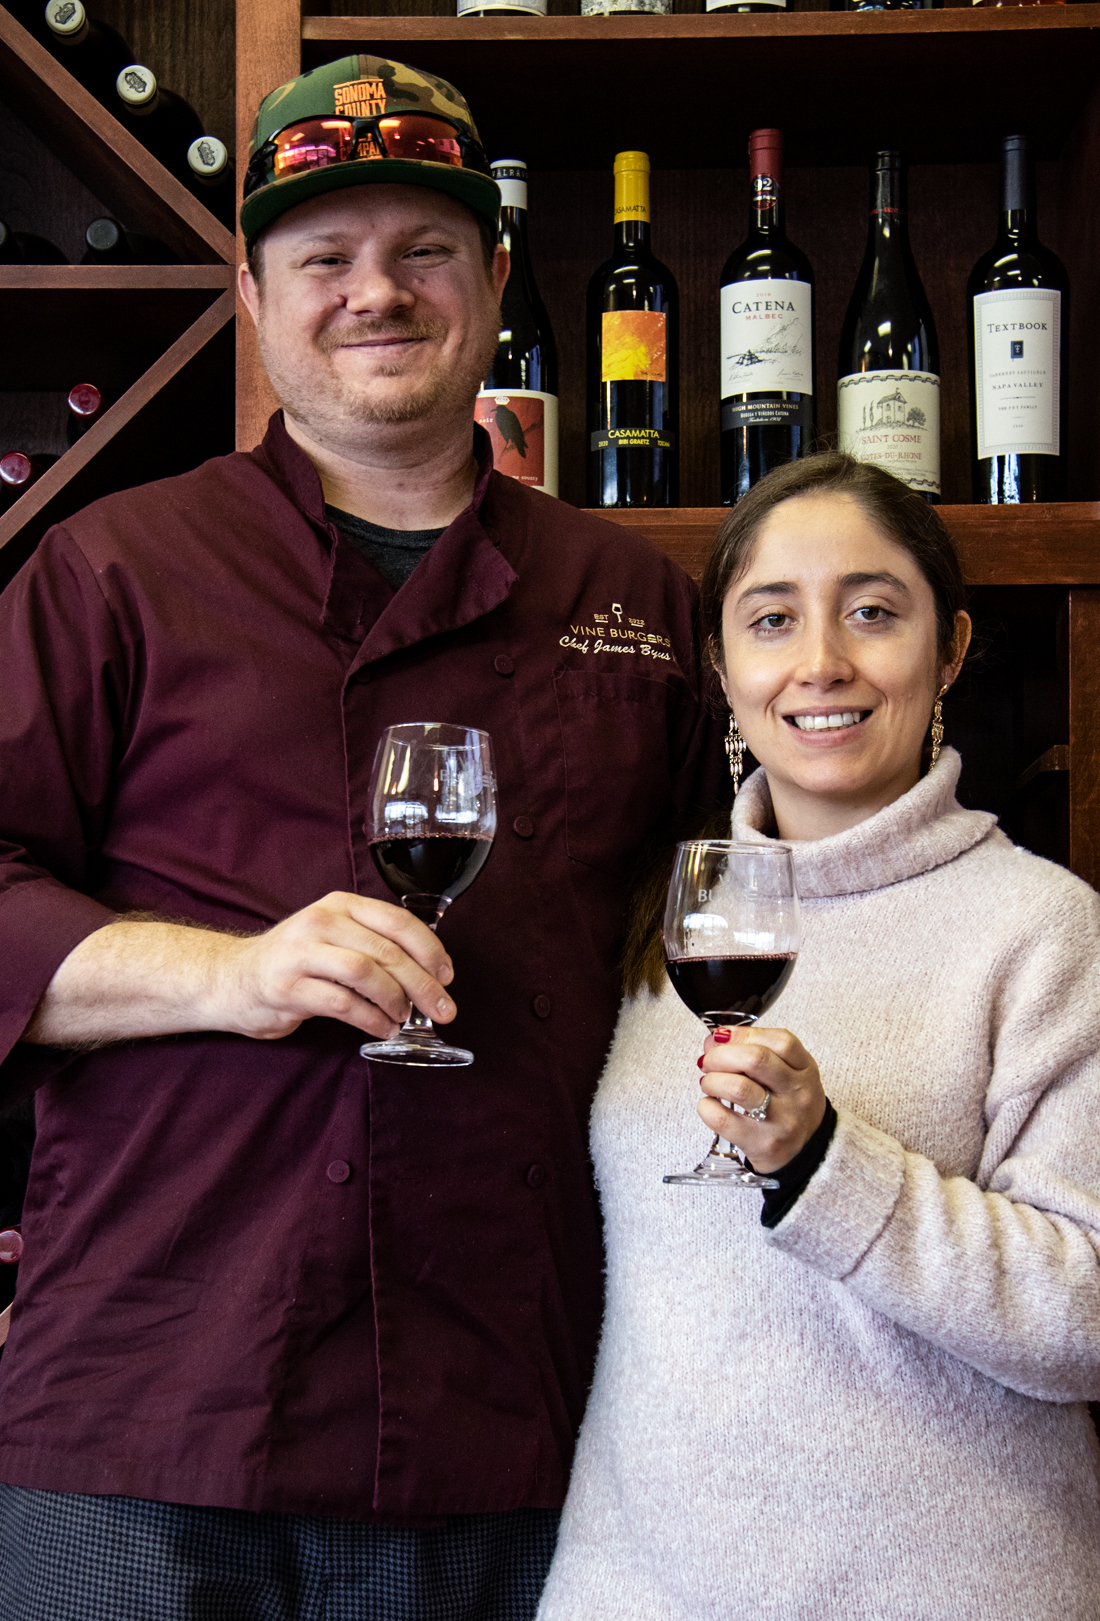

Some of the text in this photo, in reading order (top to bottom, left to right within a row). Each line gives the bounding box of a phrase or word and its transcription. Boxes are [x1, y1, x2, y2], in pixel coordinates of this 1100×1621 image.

[334, 82, 387, 106] SONOMA
[754, 177, 773, 191] 92
[731, 300, 796, 314] CATENA
[745, 313, 784, 321] MALBEC
[987, 322, 1048, 333] TEXTBOOK
[608, 429, 660, 439] CASAMATTA
[861, 433, 922, 445] SAINT COSME
[570, 624, 671, 648] VINE BURGERS
[559, 635, 671, 661] Chef James Byus
